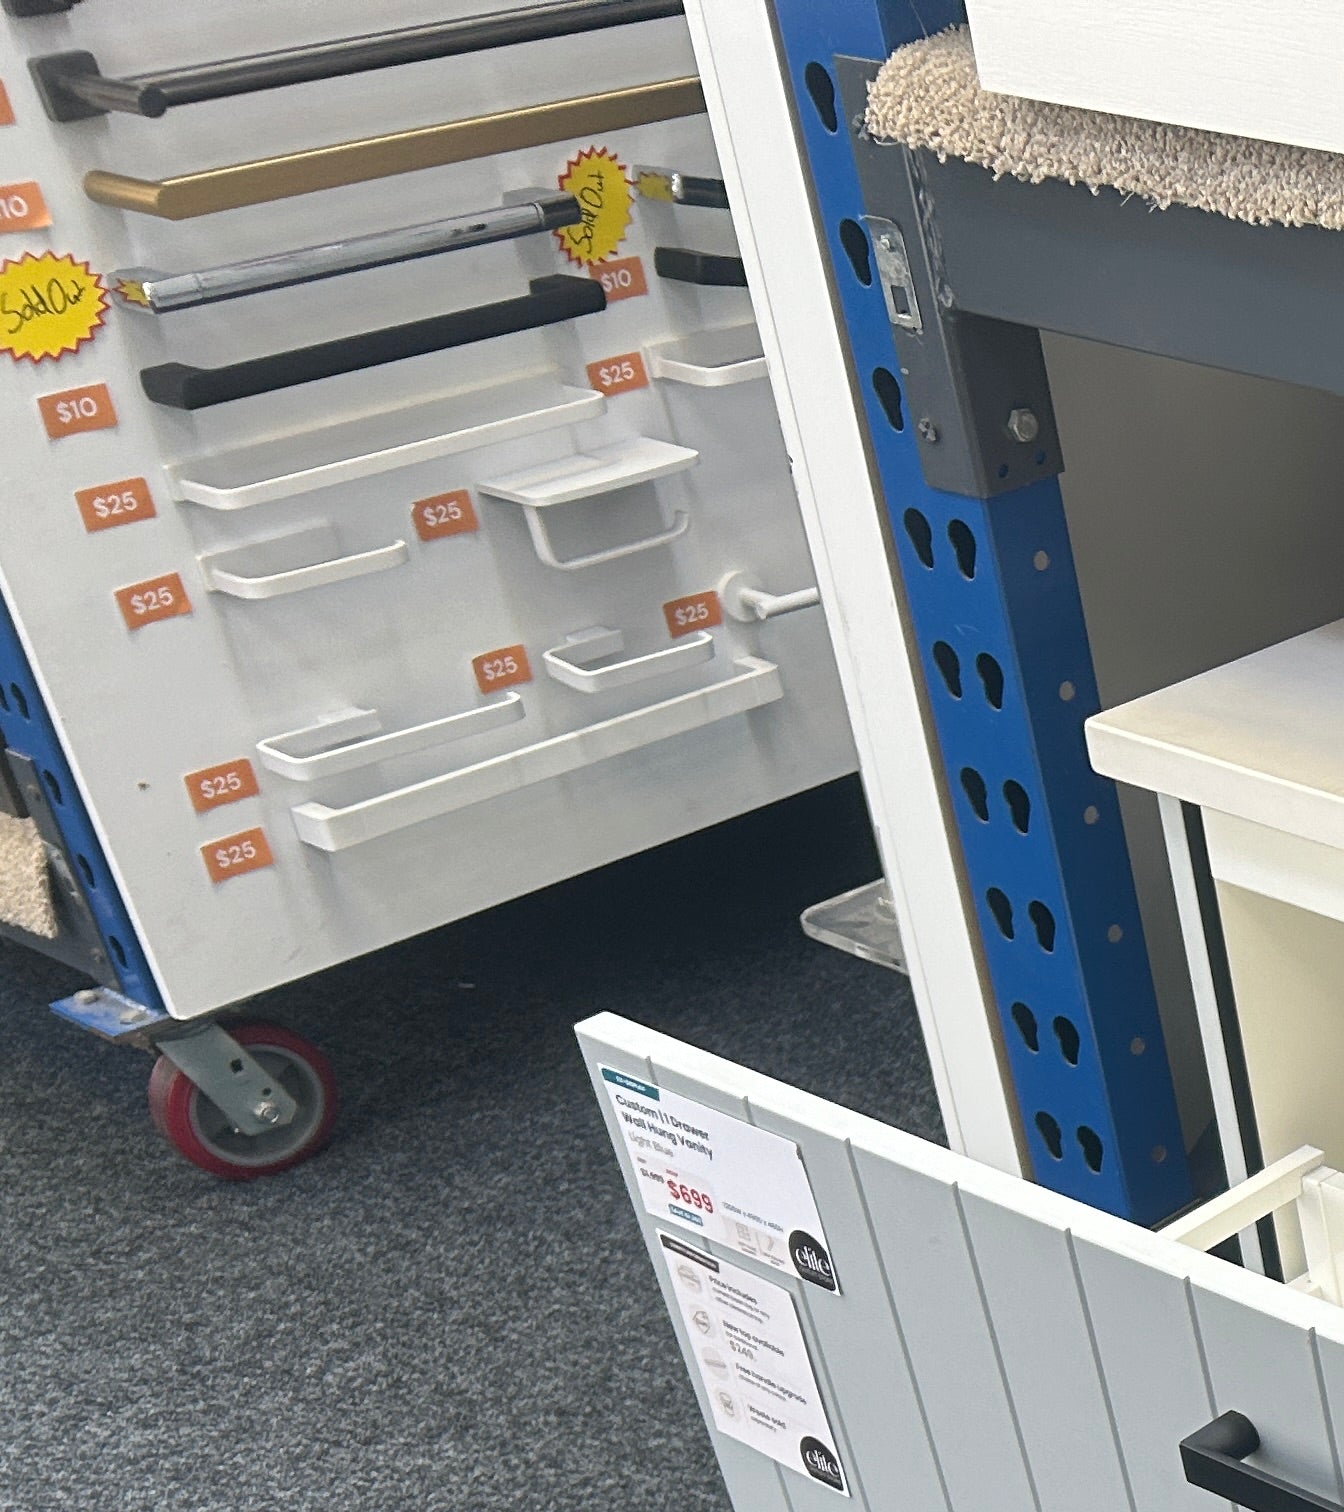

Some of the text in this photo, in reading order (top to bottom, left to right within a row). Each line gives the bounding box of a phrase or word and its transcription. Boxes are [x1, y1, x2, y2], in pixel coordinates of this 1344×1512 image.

[0, 195, 28, 219] 10
[601, 269, 632, 293] $10
[1, 284, 54, 335] Sold
[600, 361, 634, 386] $25
[56, 397, 98, 423] $10
[93, 491, 138, 518] $25
[423, 501, 462, 527] $25
[130, 587, 174, 615] $25
[673, 603, 709, 626] $25
[482, 656, 518, 681] $25
[200, 772, 241, 799] $25
[215, 840, 257, 868] $25
[647, 1121, 677, 1146] Hung
[676, 1133, 712, 1161] Vanity
[667, 1179, 713, 1214] $699
